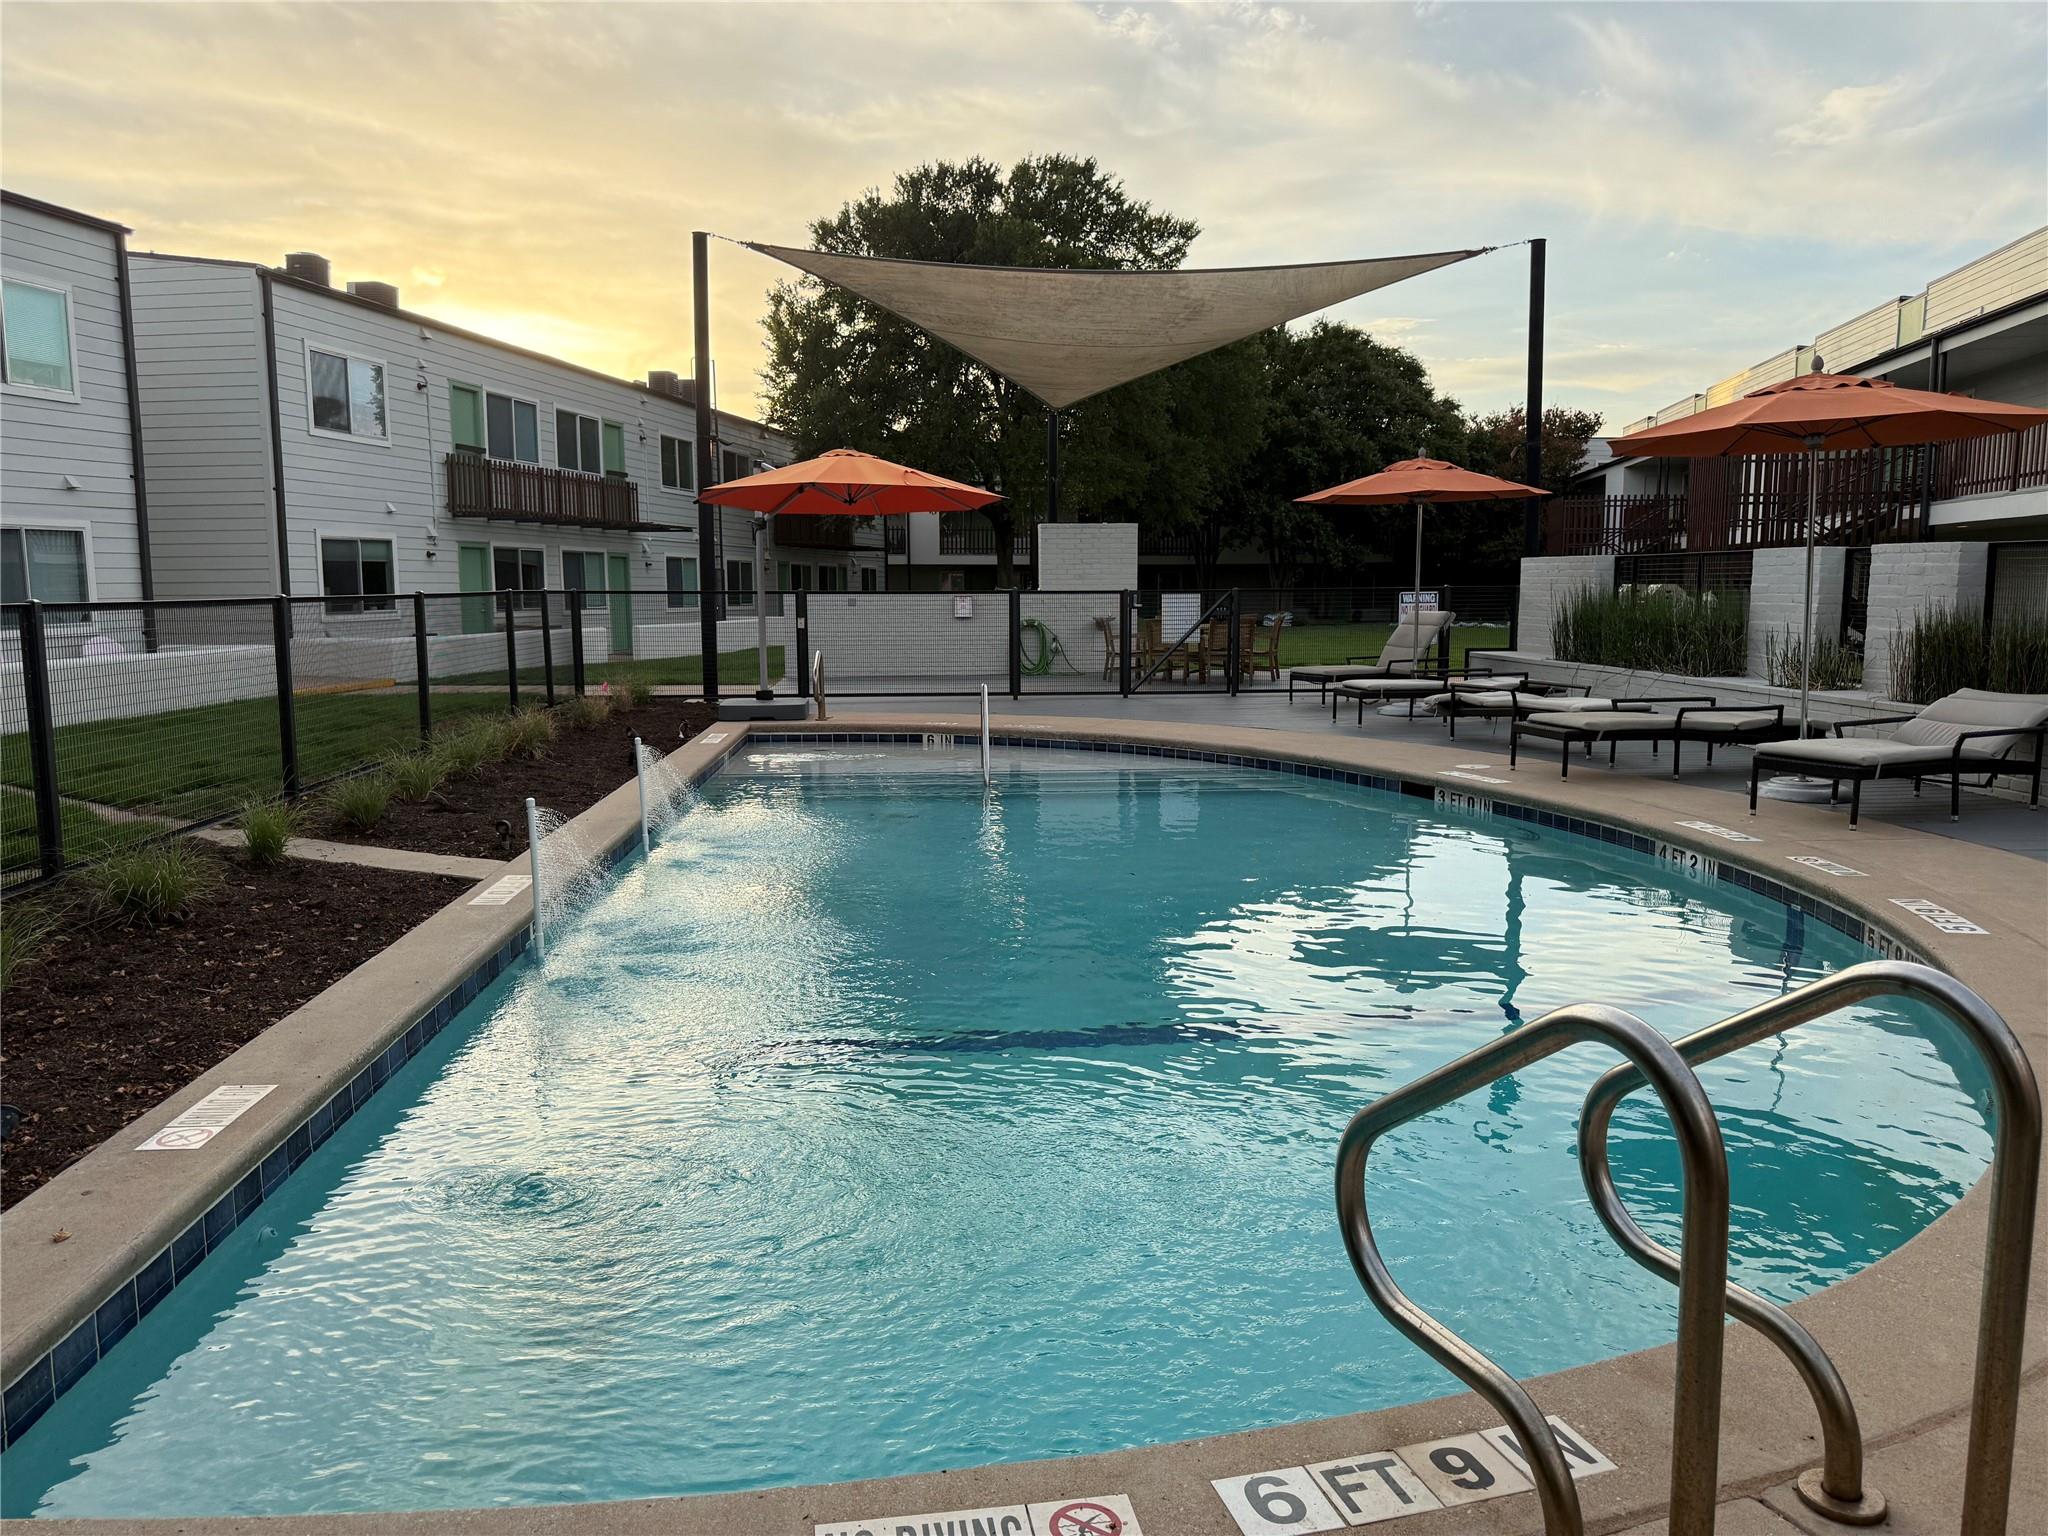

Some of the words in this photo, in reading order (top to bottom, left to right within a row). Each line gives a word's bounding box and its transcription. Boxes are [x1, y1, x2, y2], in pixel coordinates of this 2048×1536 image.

[1402, 594, 1436, 603] WARNING
[927, 734, 935, 744] 6
[940, 734, 952, 744] IN
[1438, 790, 1446, 802] 3
[1450, 792, 1463, 806] FT
[1479, 798, 1491, 812] IN
[1658, 844, 1667, 859] 4
[1672, 848, 1686, 864] FT
[1703, 858, 1716, 876] IN
[1925, 915, 1967, 924] FT
[1867, 926, 1875, 948] 5
[1879, 934, 1893, 960] FT
[177, 1099, 252, 1125] DIVING
[1242, 1474, 1307, 1525] 6
[1319, 1458, 1414, 1514] FT
[1429, 1446, 1496, 1490] 9
